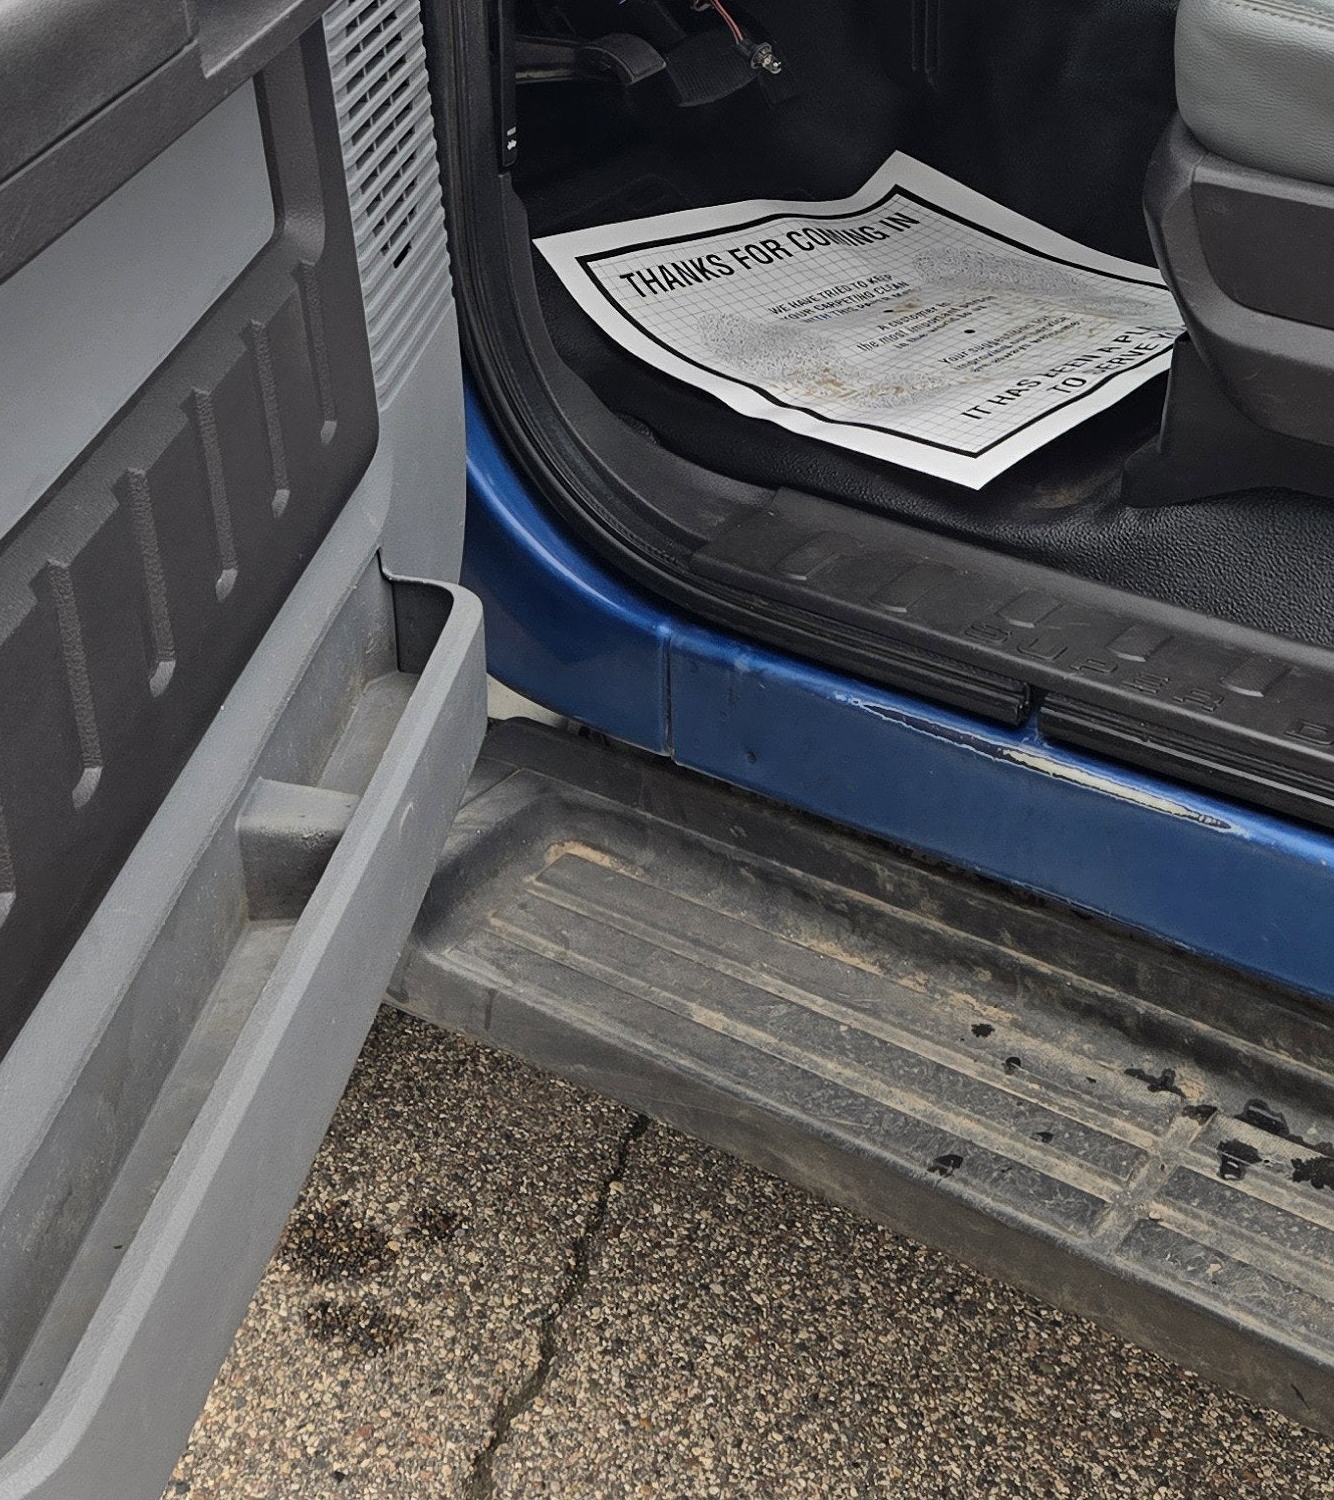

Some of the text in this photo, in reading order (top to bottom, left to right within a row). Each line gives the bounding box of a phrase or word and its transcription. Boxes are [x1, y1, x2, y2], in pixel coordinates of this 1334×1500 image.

[620, 212, 920, 298] THANKS FOR COMING IN
[768, 273, 894, 315] WE HAVE TRIED TO KEEP
[814, 291, 875, 311] CARPETING
[873, 280, 910, 295] CLEAN
[888, 306, 938, 327] customer
[857, 340, 879, 351] the
[878, 329, 909, 345] most
[937, 350, 969, 365] Your
[961, 404, 992, 420] IT
[988, 378, 1043, 406] HAS
[1099, 345, 1122, 353] A
[1046, 376, 1087, 394] TO
